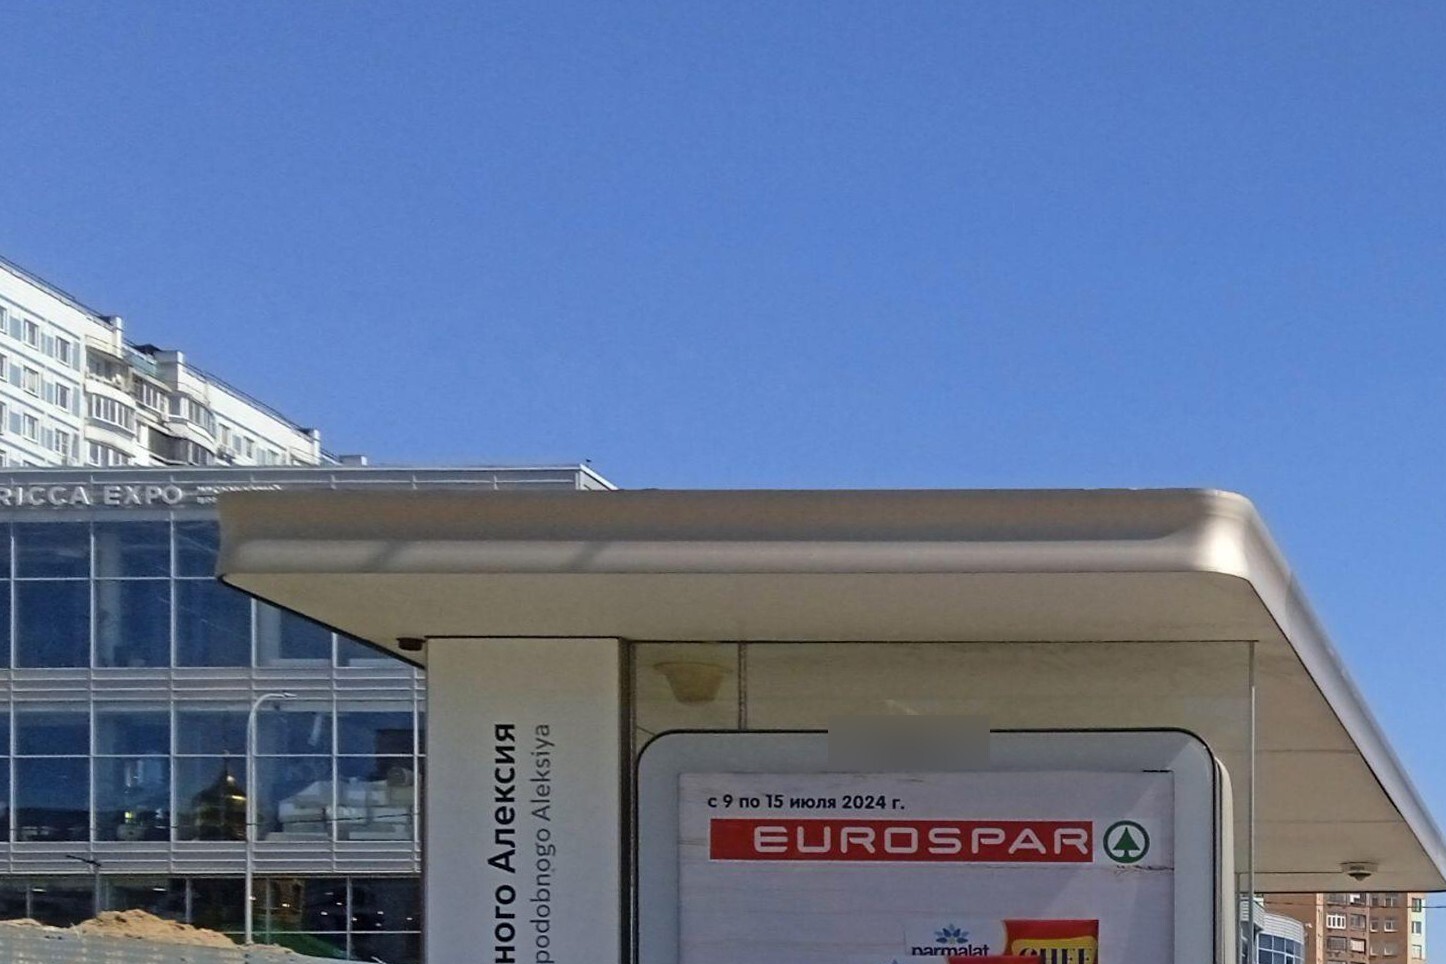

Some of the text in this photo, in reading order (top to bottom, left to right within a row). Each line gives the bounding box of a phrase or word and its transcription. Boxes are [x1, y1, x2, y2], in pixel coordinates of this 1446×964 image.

[103, 485, 183, 505] EXPO
[530, 724, 555, 821] Aleksiya
[487, 723, 516, 873] Алексия
[707, 794, 905, 810] с 9 по 15 июля 2024 г.
[754, 826, 1089, 855] EUROSPAR
